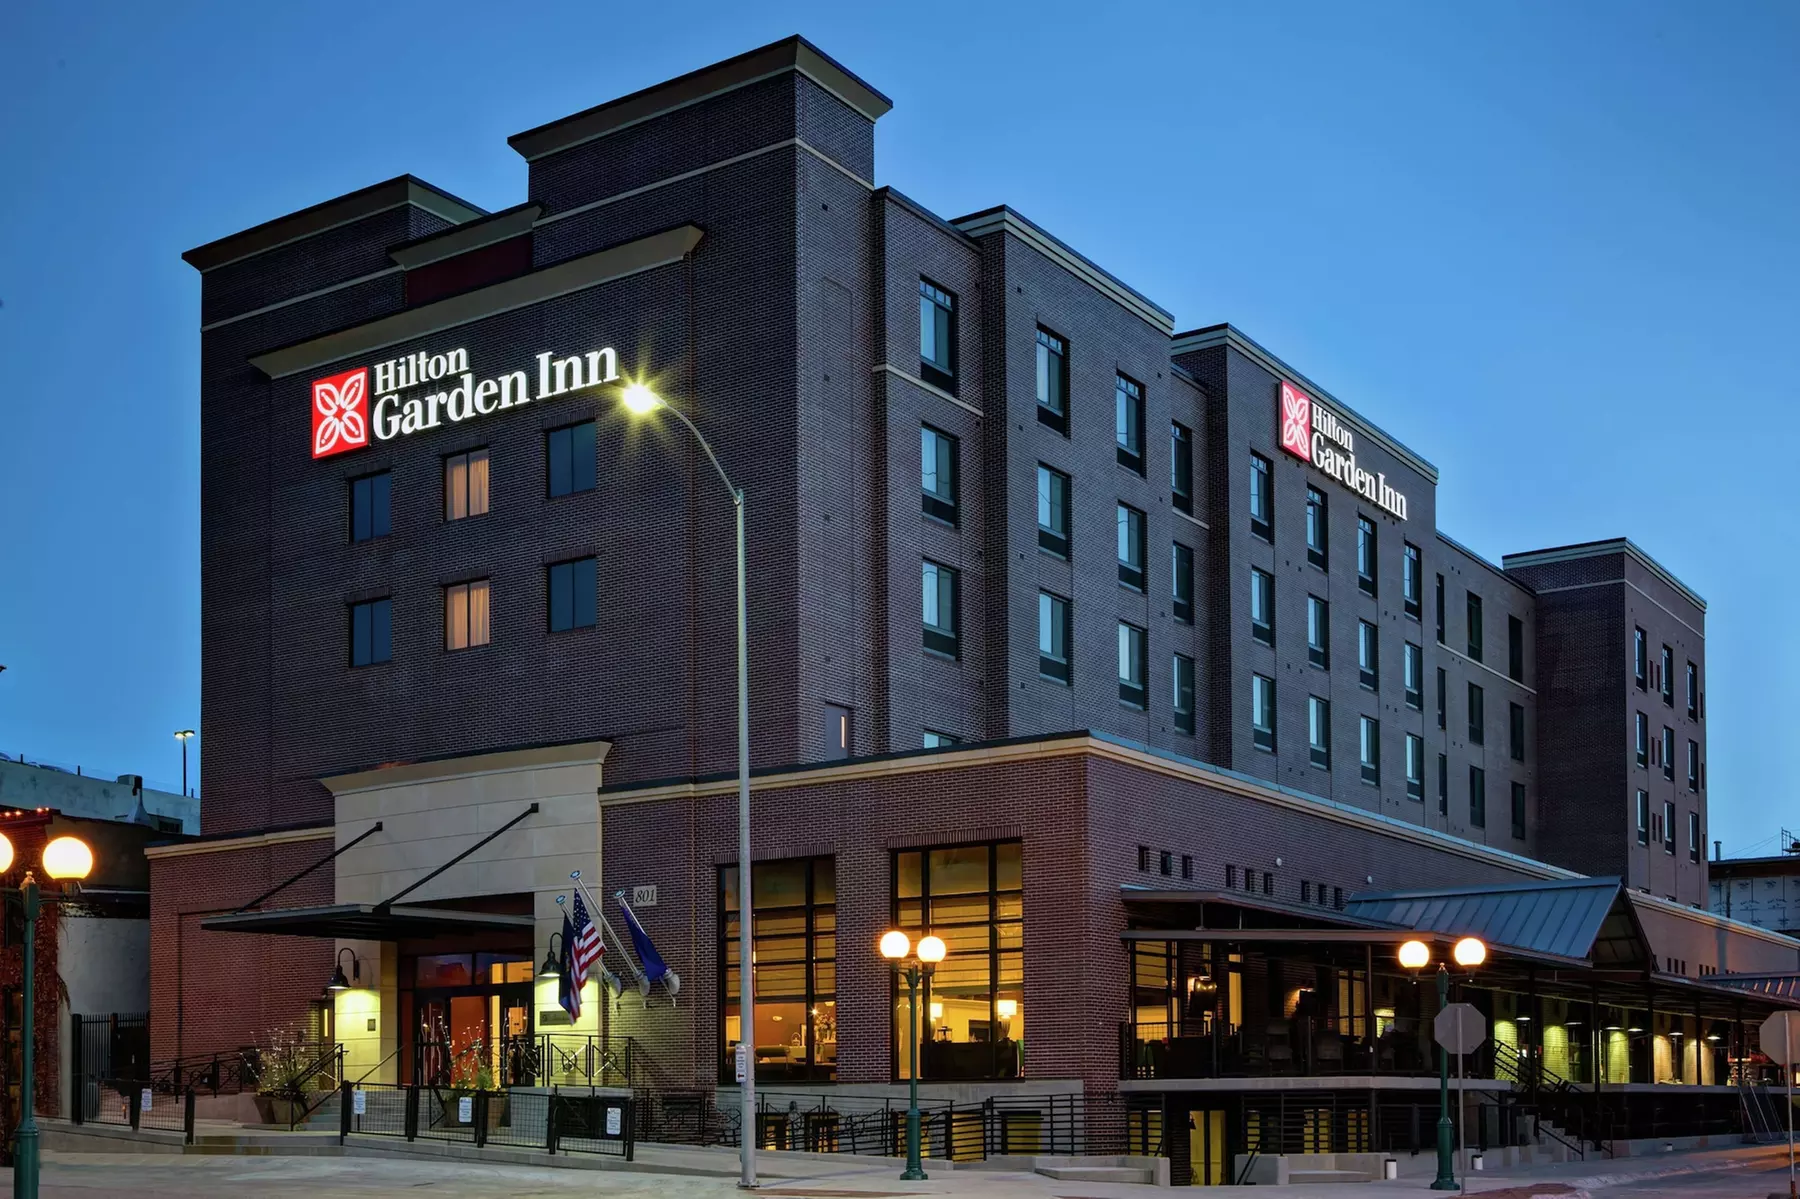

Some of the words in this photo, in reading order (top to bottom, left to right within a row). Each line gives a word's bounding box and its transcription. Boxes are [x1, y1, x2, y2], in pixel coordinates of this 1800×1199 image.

[372, 370, 531, 440] Garden
[535, 346, 620, 400] Inn
[373, 347, 470, 396] Hilton
[1311, 402, 1354, 452] Hilton
[1311, 432, 1377, 502] Garden
[1377, 472, 1408, 521] Inn
[635, 889, 655, 903] 801
